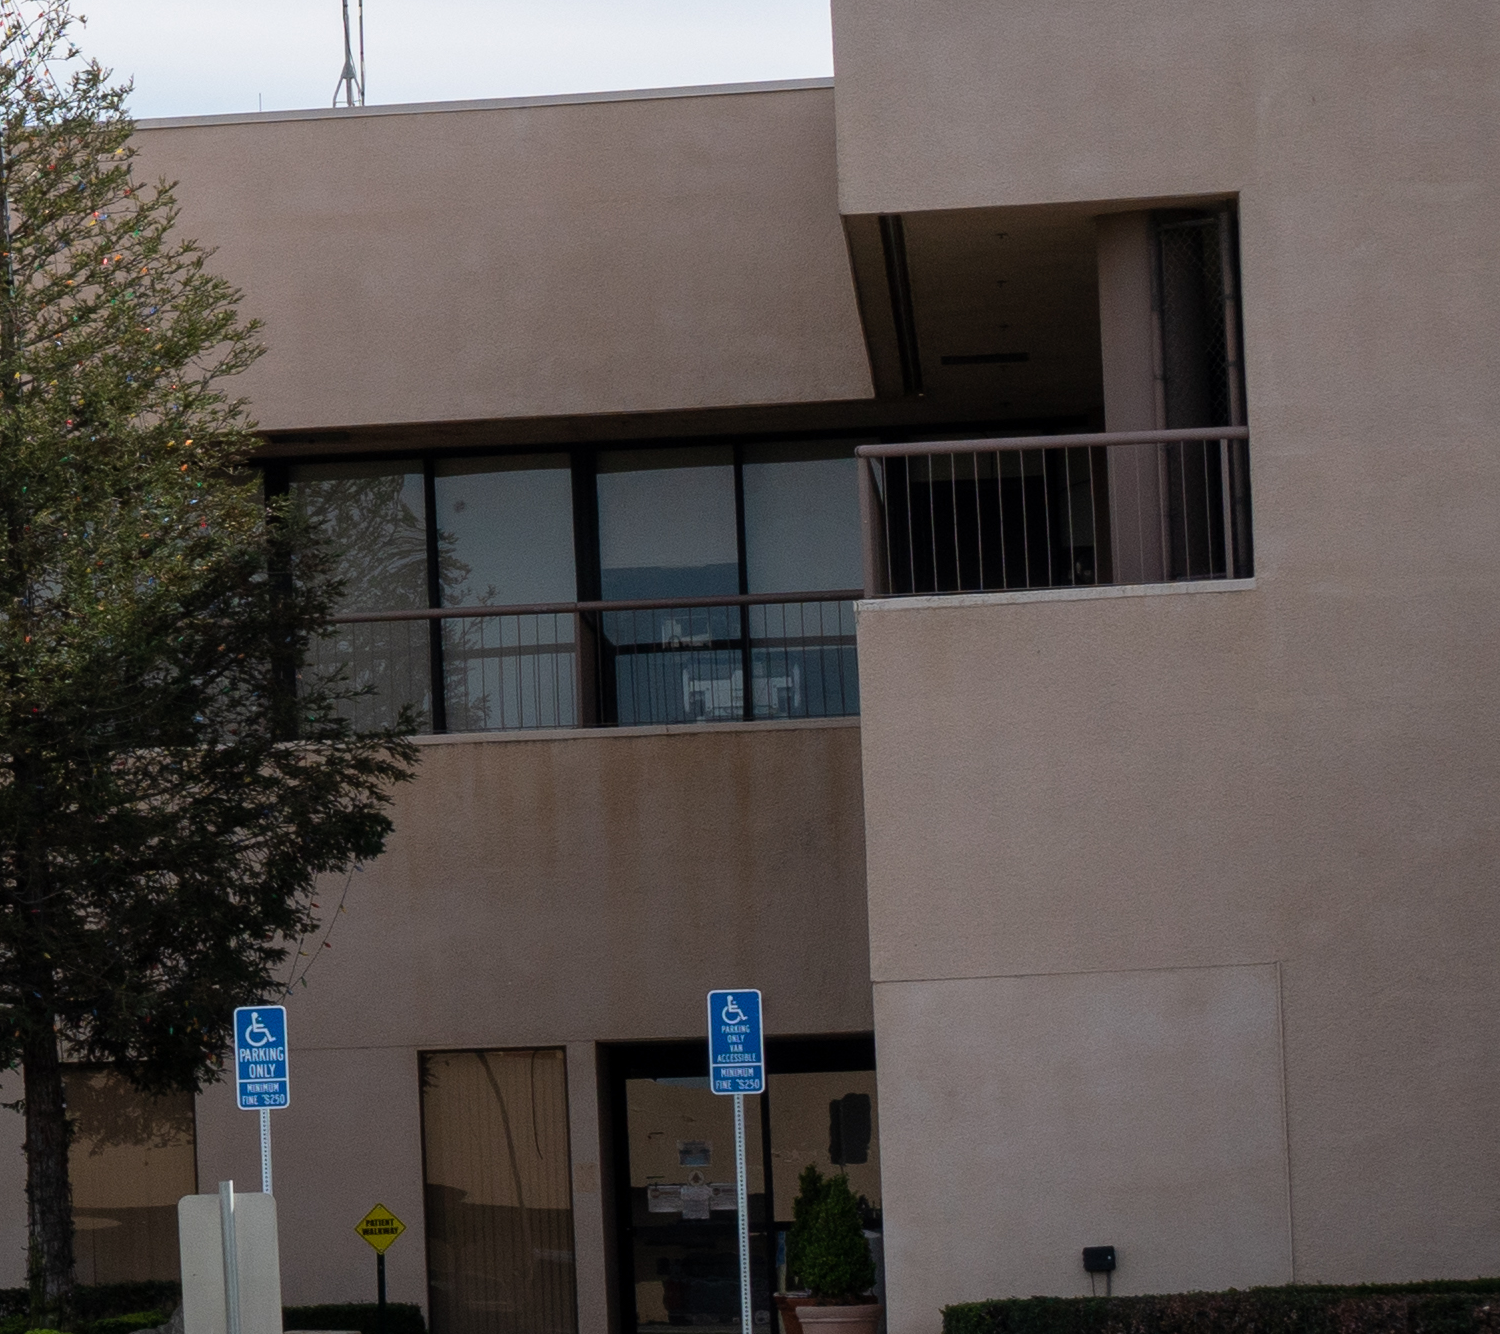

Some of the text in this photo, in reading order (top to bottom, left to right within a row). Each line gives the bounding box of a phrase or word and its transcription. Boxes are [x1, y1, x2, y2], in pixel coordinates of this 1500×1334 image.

[721, 1025, 750, 1033] PARKING
[727, 1034, 745, 1043] ONLY
[729, 1044, 743, 1052] VAN
[240, 1047, 284, 1062] PARKING
[717, 1053, 756, 1062] ACCESSIBLE
[248, 1064, 276, 1078] ONLY
[721, 1067, 754, 1077] MINIMUM
[247, 1083, 279, 1093] MINIMUM
[715, 1080, 732, 1090] FINE
[242, 1095, 258, 1105] FINE
